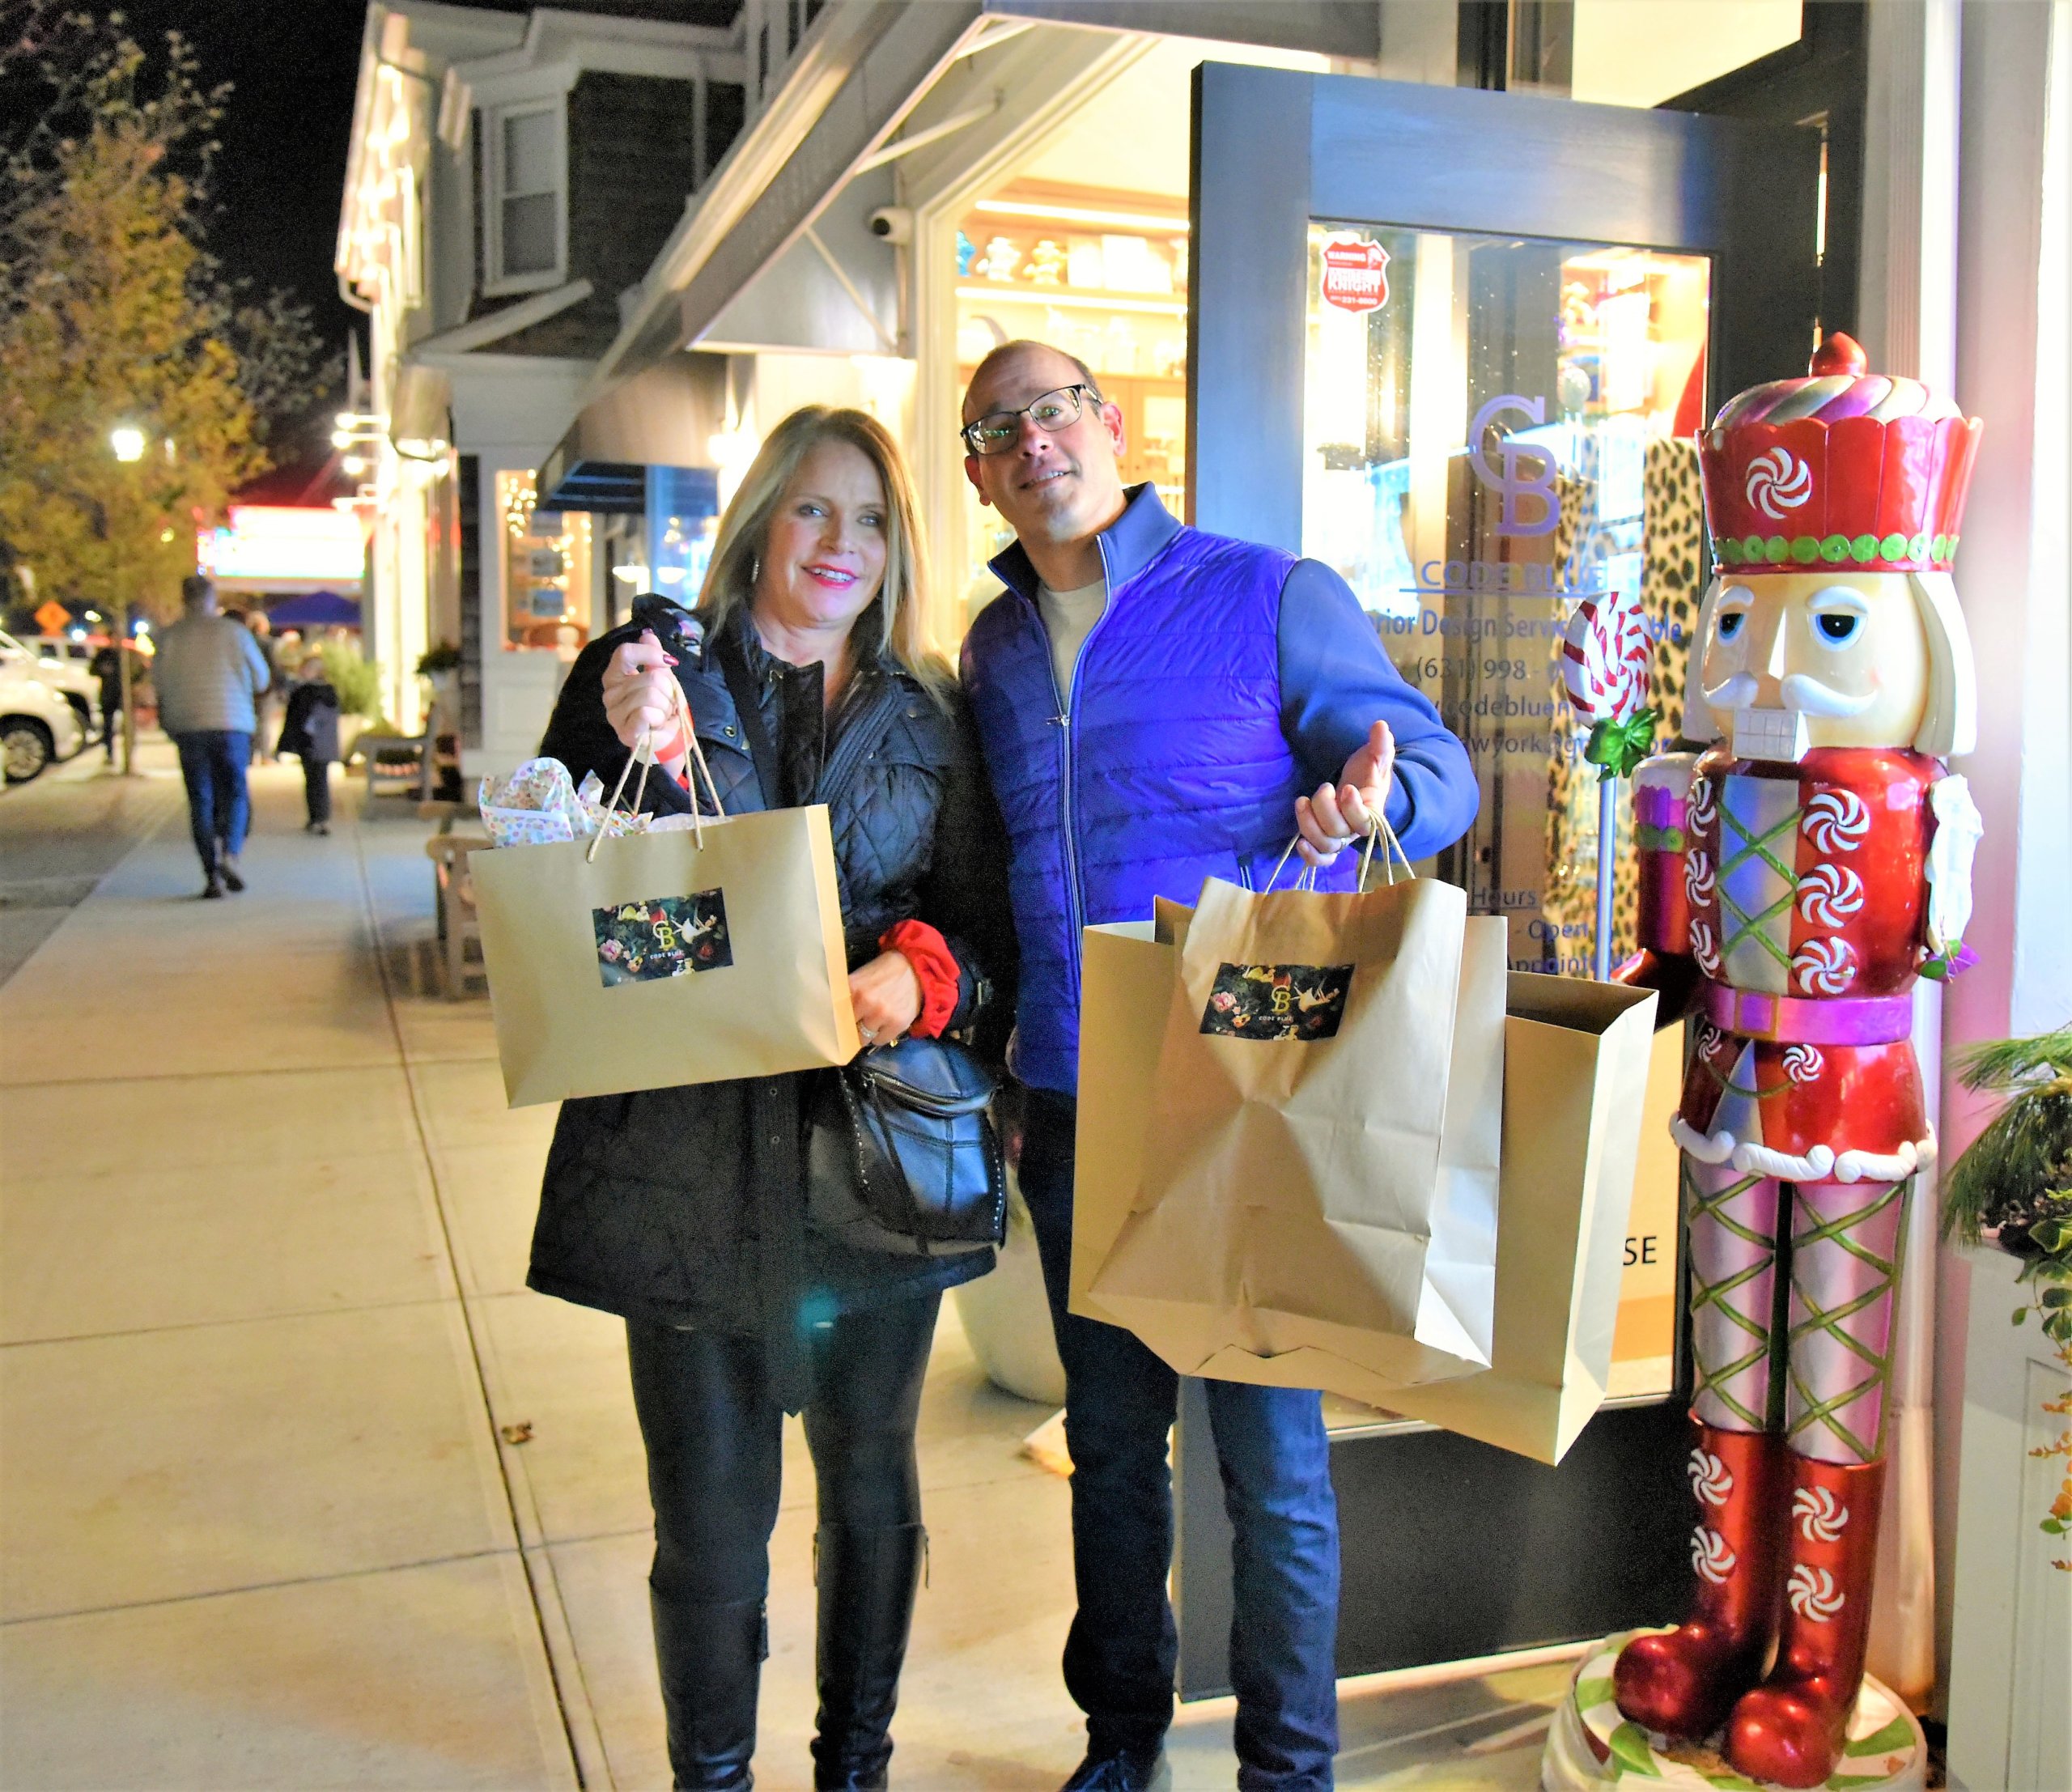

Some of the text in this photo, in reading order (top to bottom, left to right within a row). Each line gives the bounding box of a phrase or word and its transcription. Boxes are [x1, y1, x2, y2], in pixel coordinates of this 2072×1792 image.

[1328, 279, 1381, 292] KNIGHT
[1420, 559, 1603, 594] CODE BLUE
[1376, 609, 1416, 635] rior
[1422, 609, 1497, 643] Design
[1504, 612, 1569, 639] Servic
[1417, 656, 1475, 682] (631)
[1484, 658, 1526, 680] 998
[1471, 887, 1537, 906] Hours
[1529, 919, 1589, 942] Open
